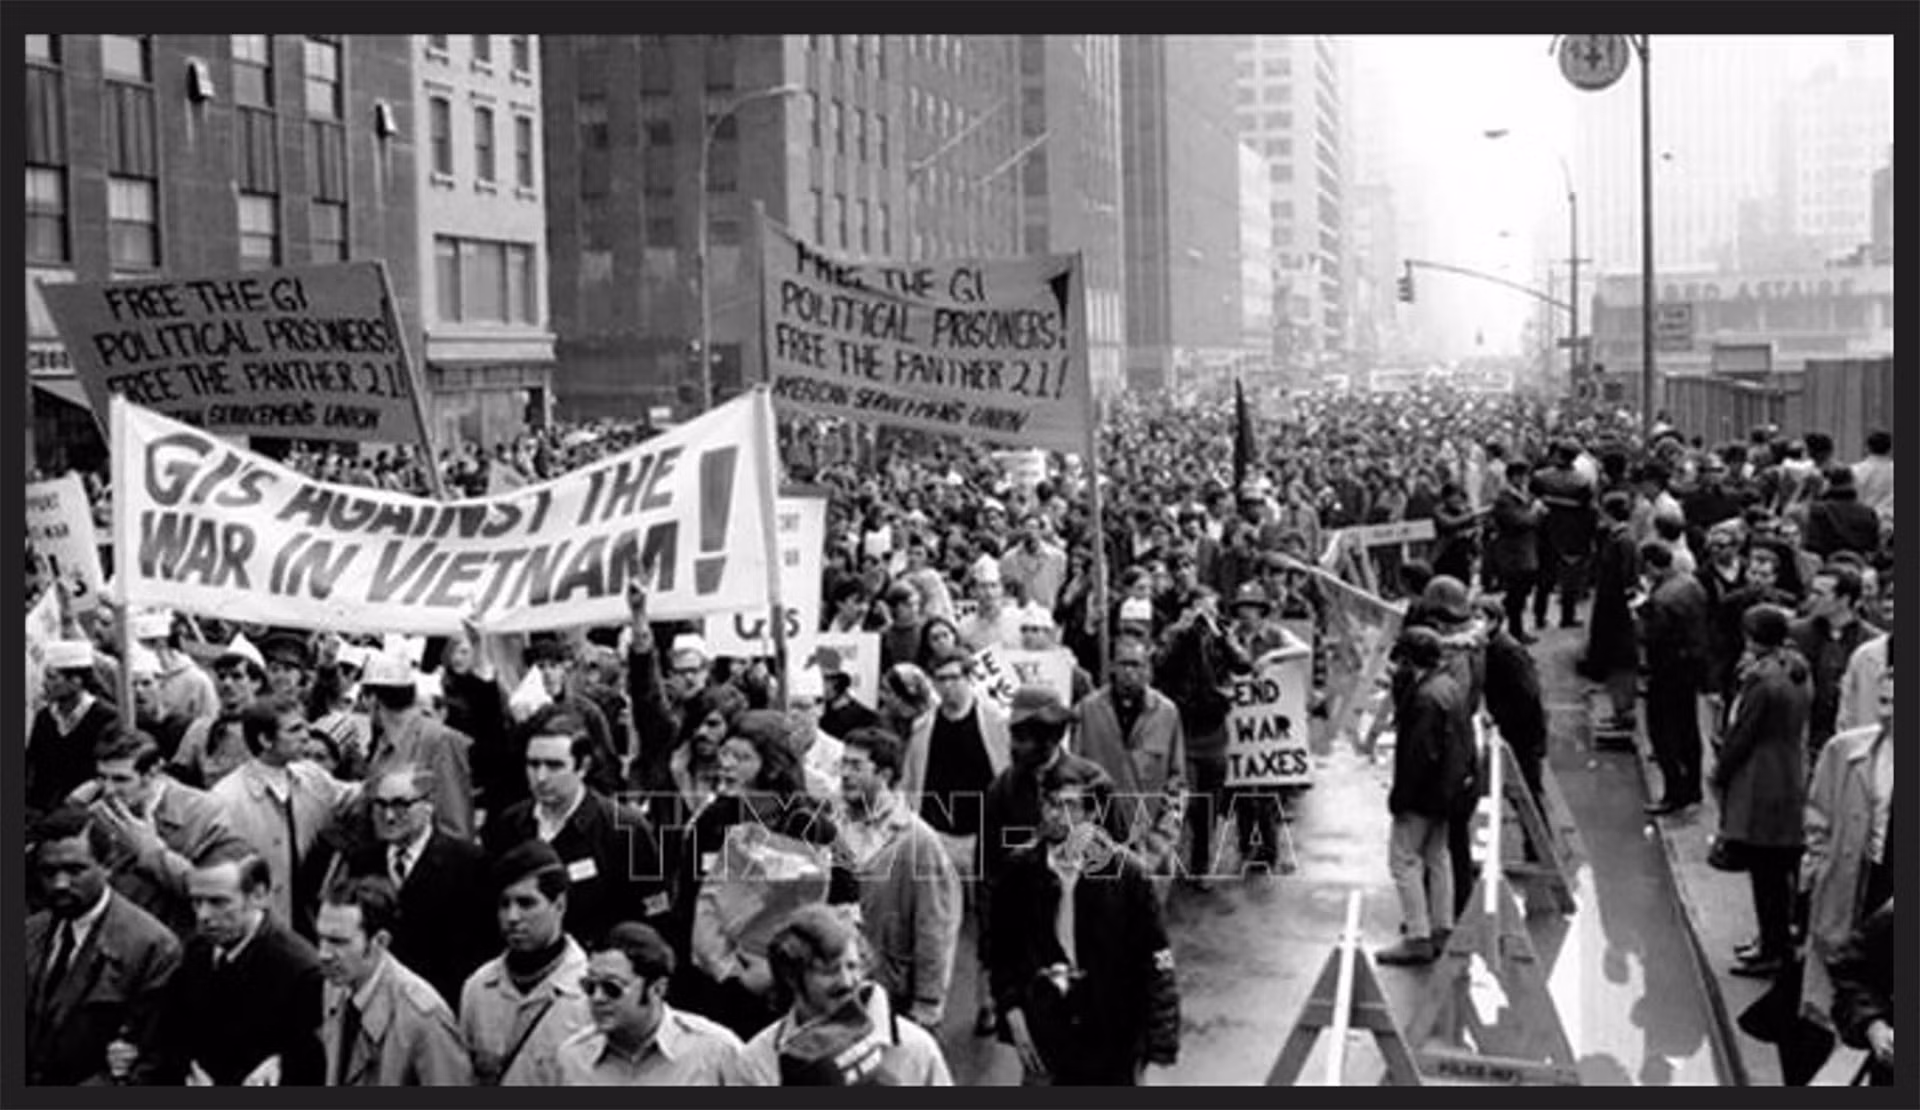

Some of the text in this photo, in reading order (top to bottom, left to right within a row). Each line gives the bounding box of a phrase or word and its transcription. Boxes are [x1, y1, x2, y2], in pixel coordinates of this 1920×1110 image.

[105, 277, 307, 321] FREE THE GI
[949, 267, 987, 302] GI
[780, 279, 915, 343] POLITICAL
[93, 320, 262, 367] POLITICAL
[775, 322, 828, 371] FREE
[836, 338, 883, 382] THE
[895, 352, 1004, 393] PANTHER
[106, 367, 182, 404] FREE
[176, 361, 235, 395] THE
[243, 360, 358, 394] PANTHER
[275, 483, 551, 540] AGAINST
[577, 445, 686, 527] THE
[138, 510, 257, 589] WAR
[269, 531, 363, 599] IN
[1235, 679, 1280, 706] END
[1235, 715, 1292, 743] WAR
[1229, 749, 1308, 778] TAXES
